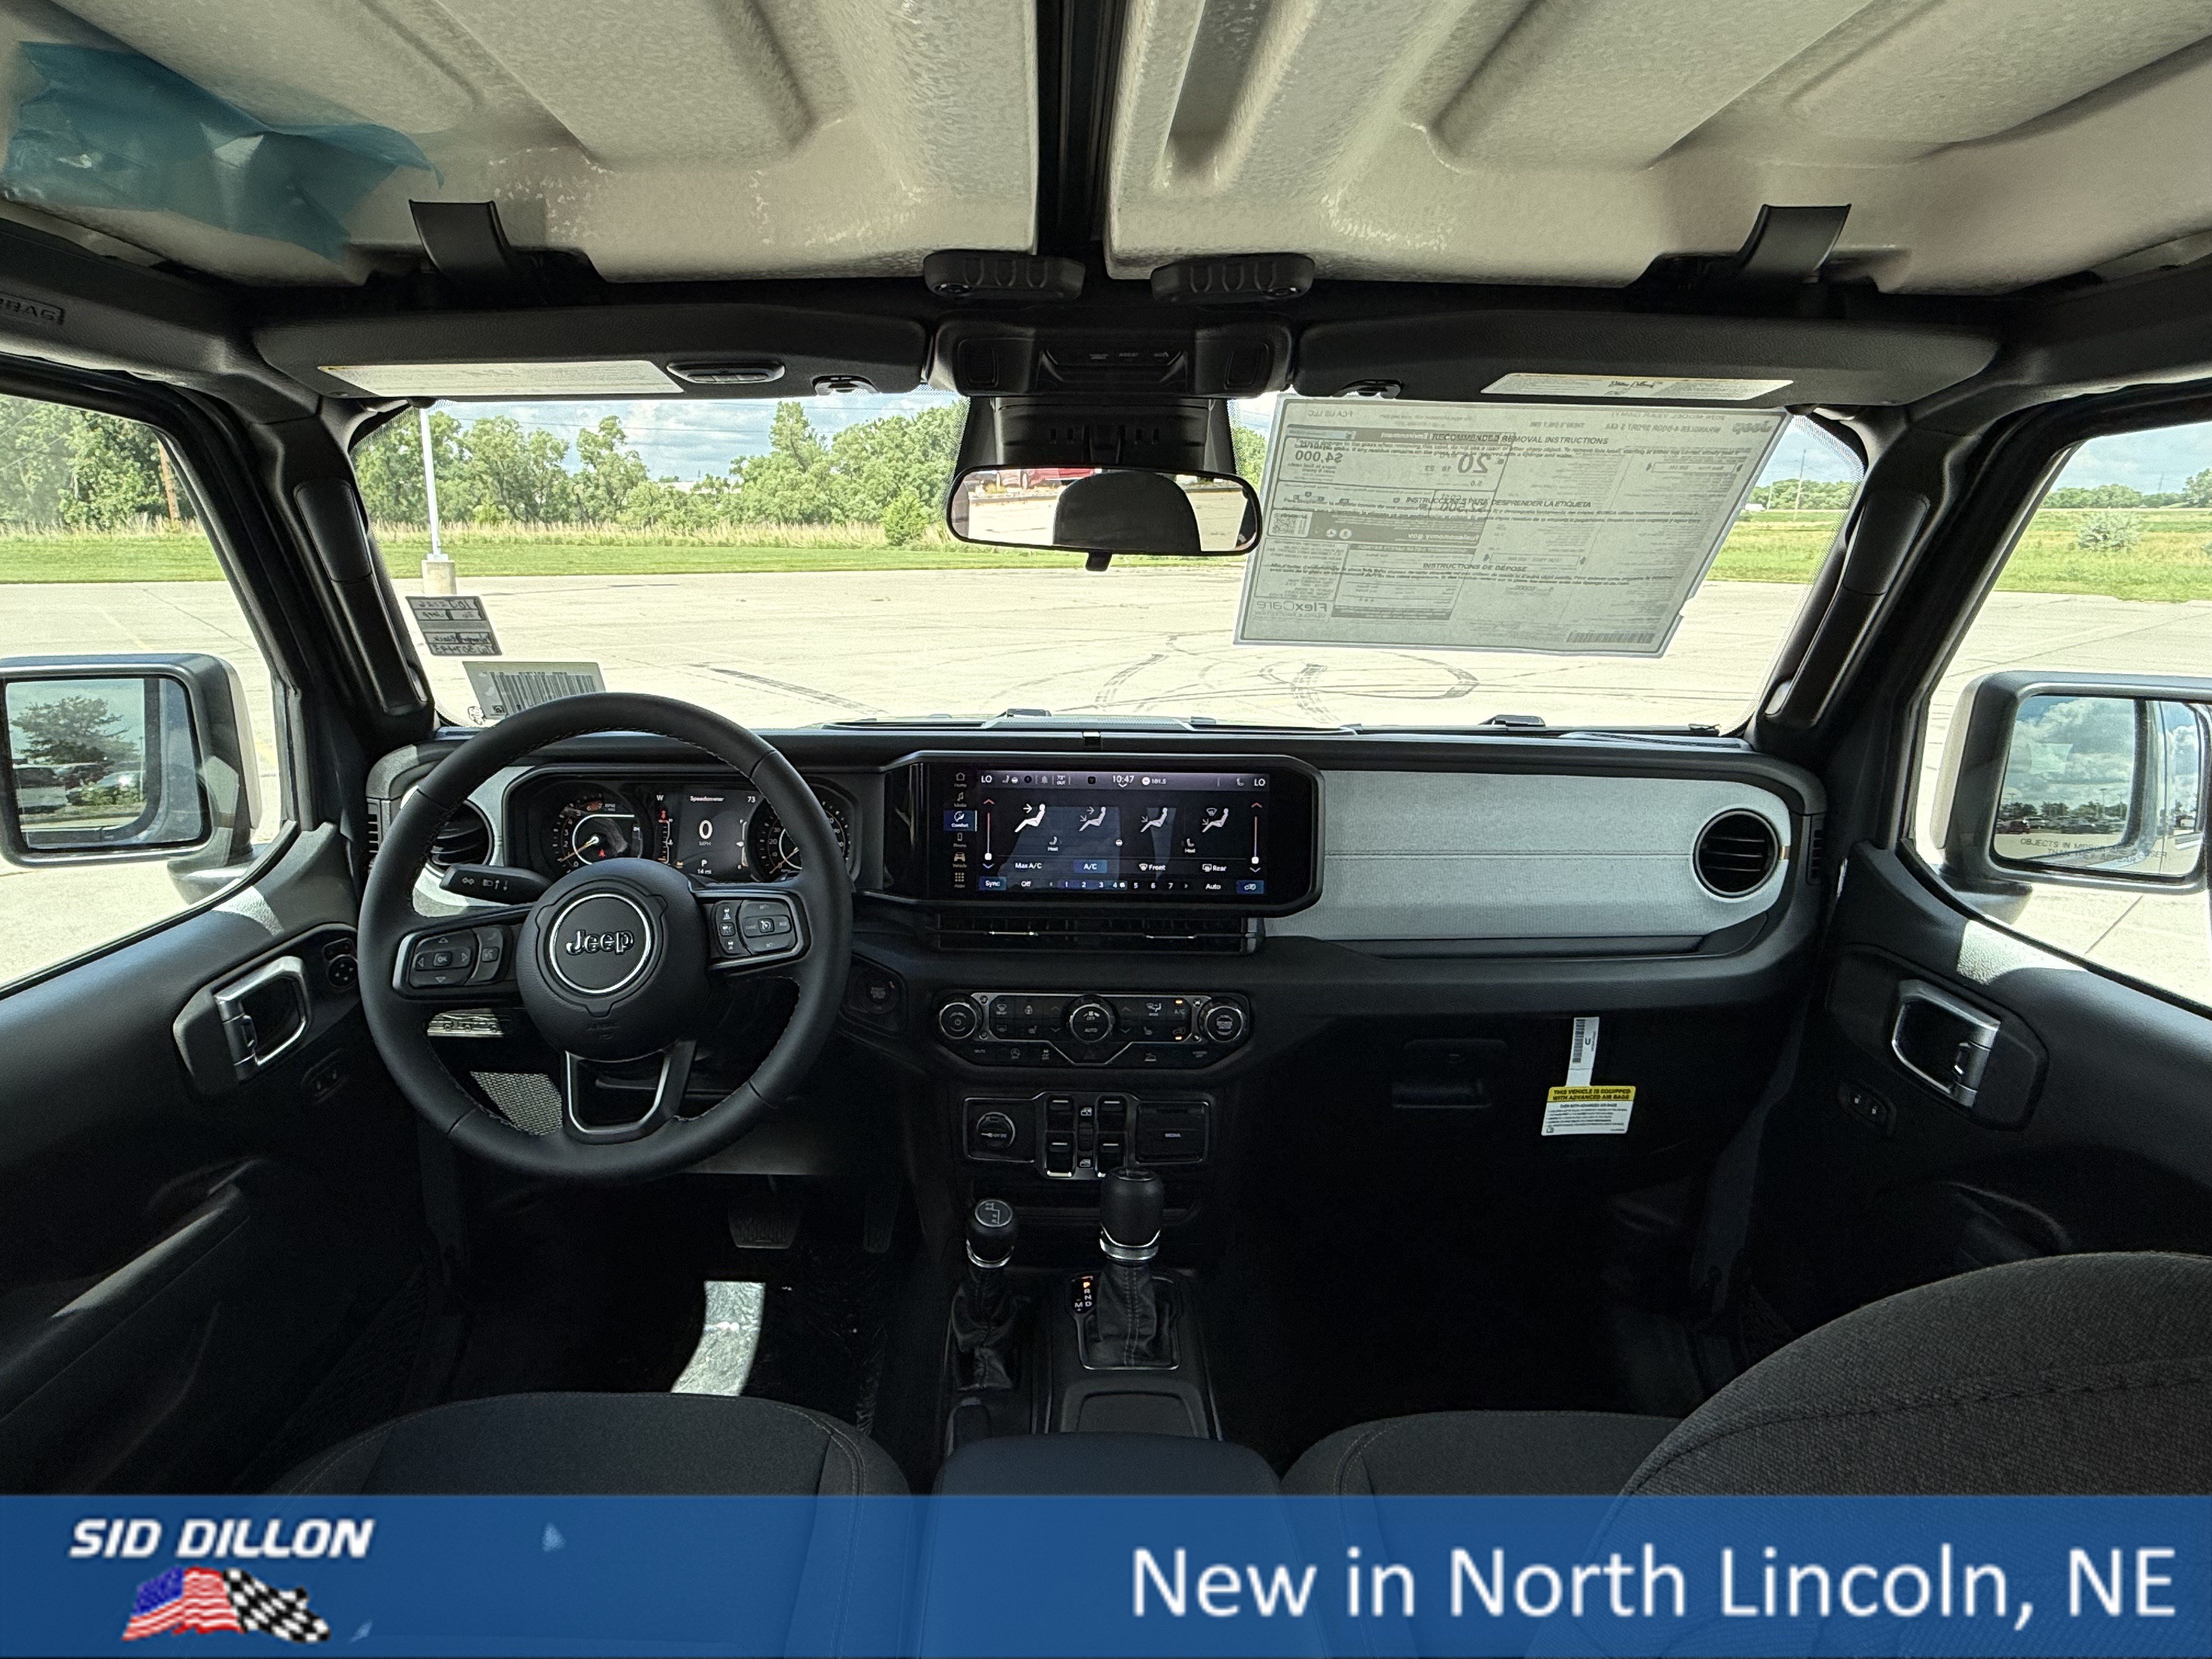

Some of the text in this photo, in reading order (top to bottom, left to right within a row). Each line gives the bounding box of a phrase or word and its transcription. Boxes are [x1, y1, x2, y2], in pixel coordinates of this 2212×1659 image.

[1431, 432, 1609, 444] RECOMMENDED REMOVAL INSTRUCTIONS
[1492, 499, 1544, 507] DESPRENDER
[981, 775, 993, 783] LO
[1112, 774, 1135, 783] 10:47
[1254, 778, 1266, 787] LO
[698, 820, 713, 839] 0
[2020, 838, 2059, 848] OBJECTS
[566, 929, 634, 955] Jeep
